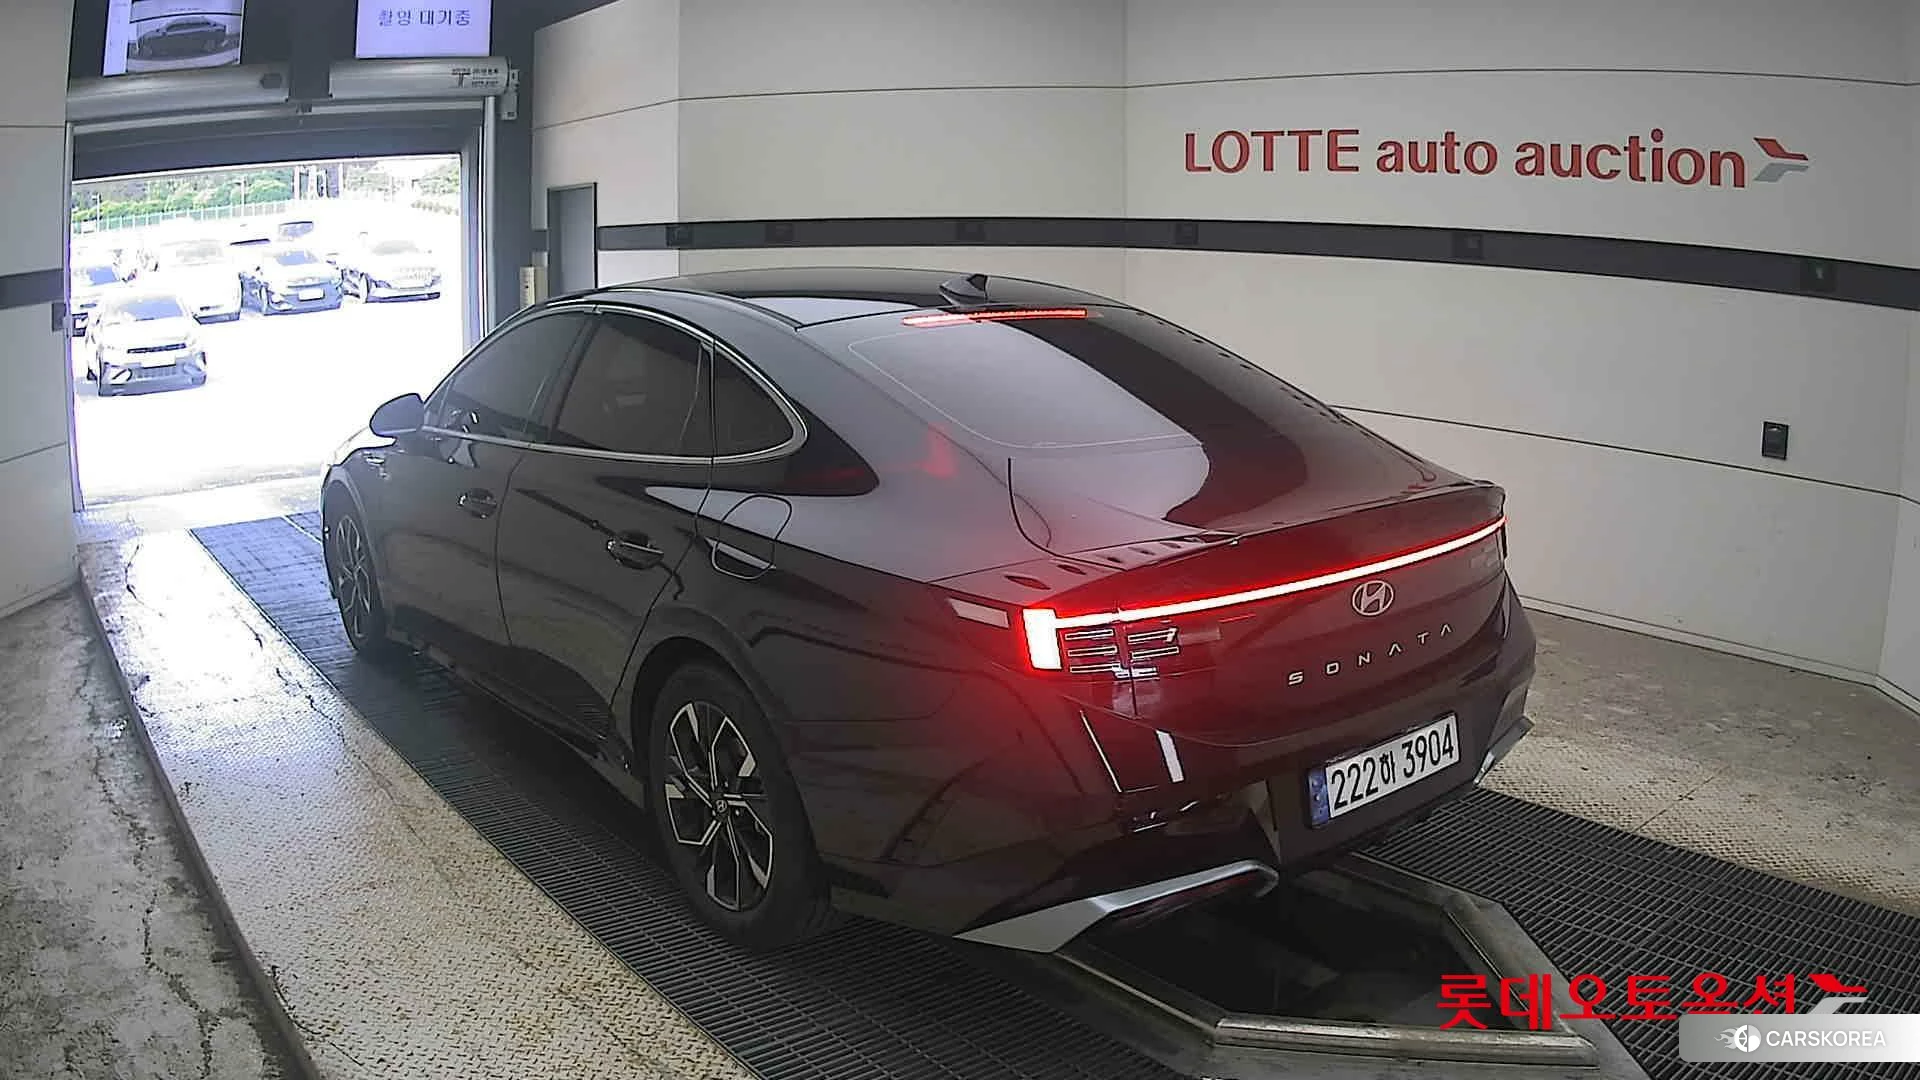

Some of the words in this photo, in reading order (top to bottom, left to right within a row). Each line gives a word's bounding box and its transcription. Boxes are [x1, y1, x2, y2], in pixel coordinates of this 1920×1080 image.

[420, 9, 471, 26] 대기중
[1185, 129, 1359, 172] LOTTE
[1377, 130, 1498, 175] auto
[1515, 128, 1746, 188] auction
[1288, 624, 1452, 685] SONATA
[1330, 751, 1397, 810] 222하
[1401, 724, 1454, 778] 3904
